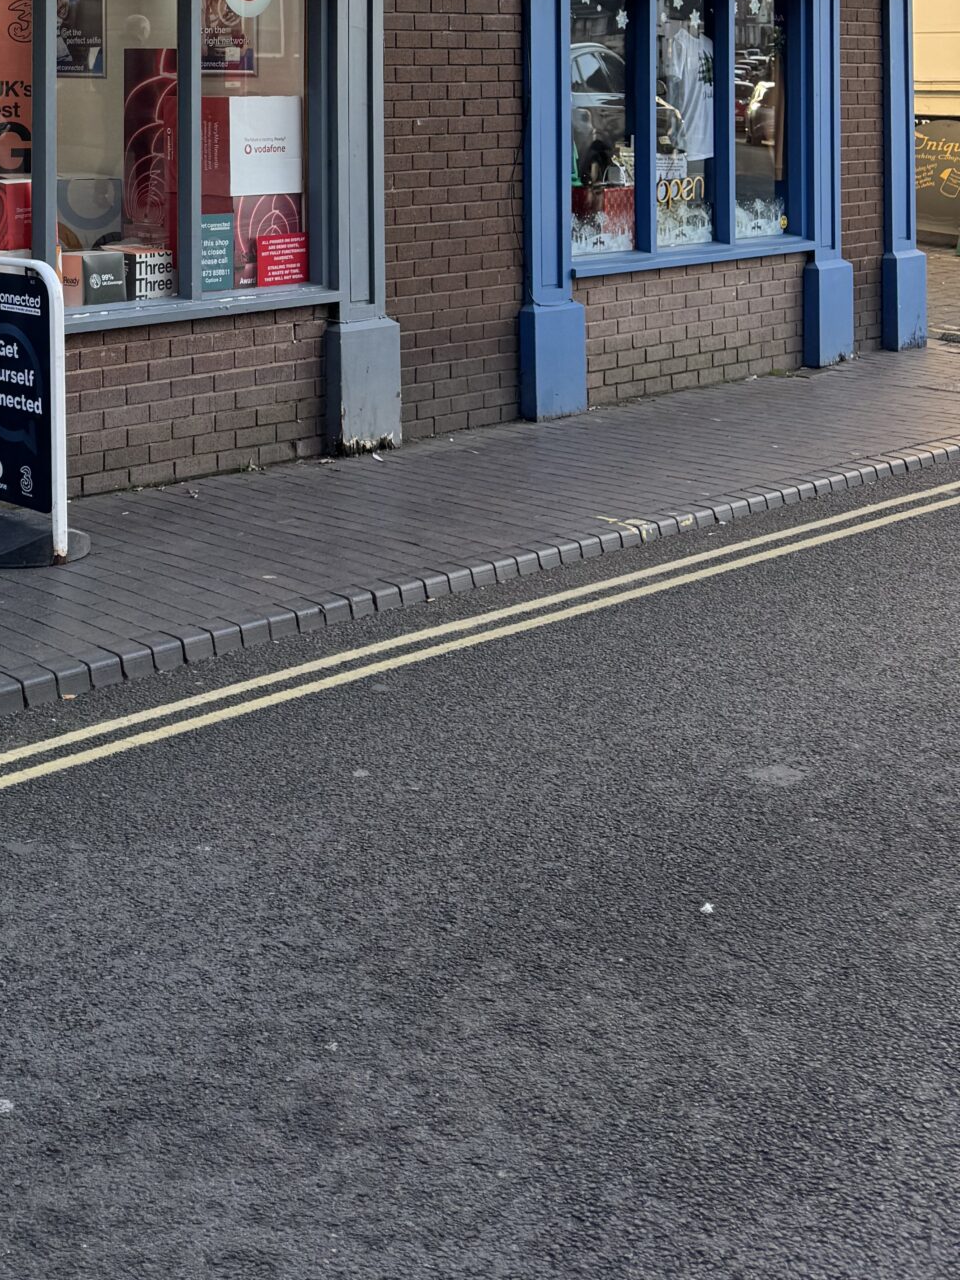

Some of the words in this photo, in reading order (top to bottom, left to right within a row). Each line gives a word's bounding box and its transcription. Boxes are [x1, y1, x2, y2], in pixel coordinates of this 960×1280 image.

[254, 144, 286, 153] vodafone
[656, 176, 705, 209] open
[215, 239, 229, 247] shop
[136, 260, 173, 276] Three
[62, 276, 80, 286] Ready
[136, 277, 173, 293] Three
